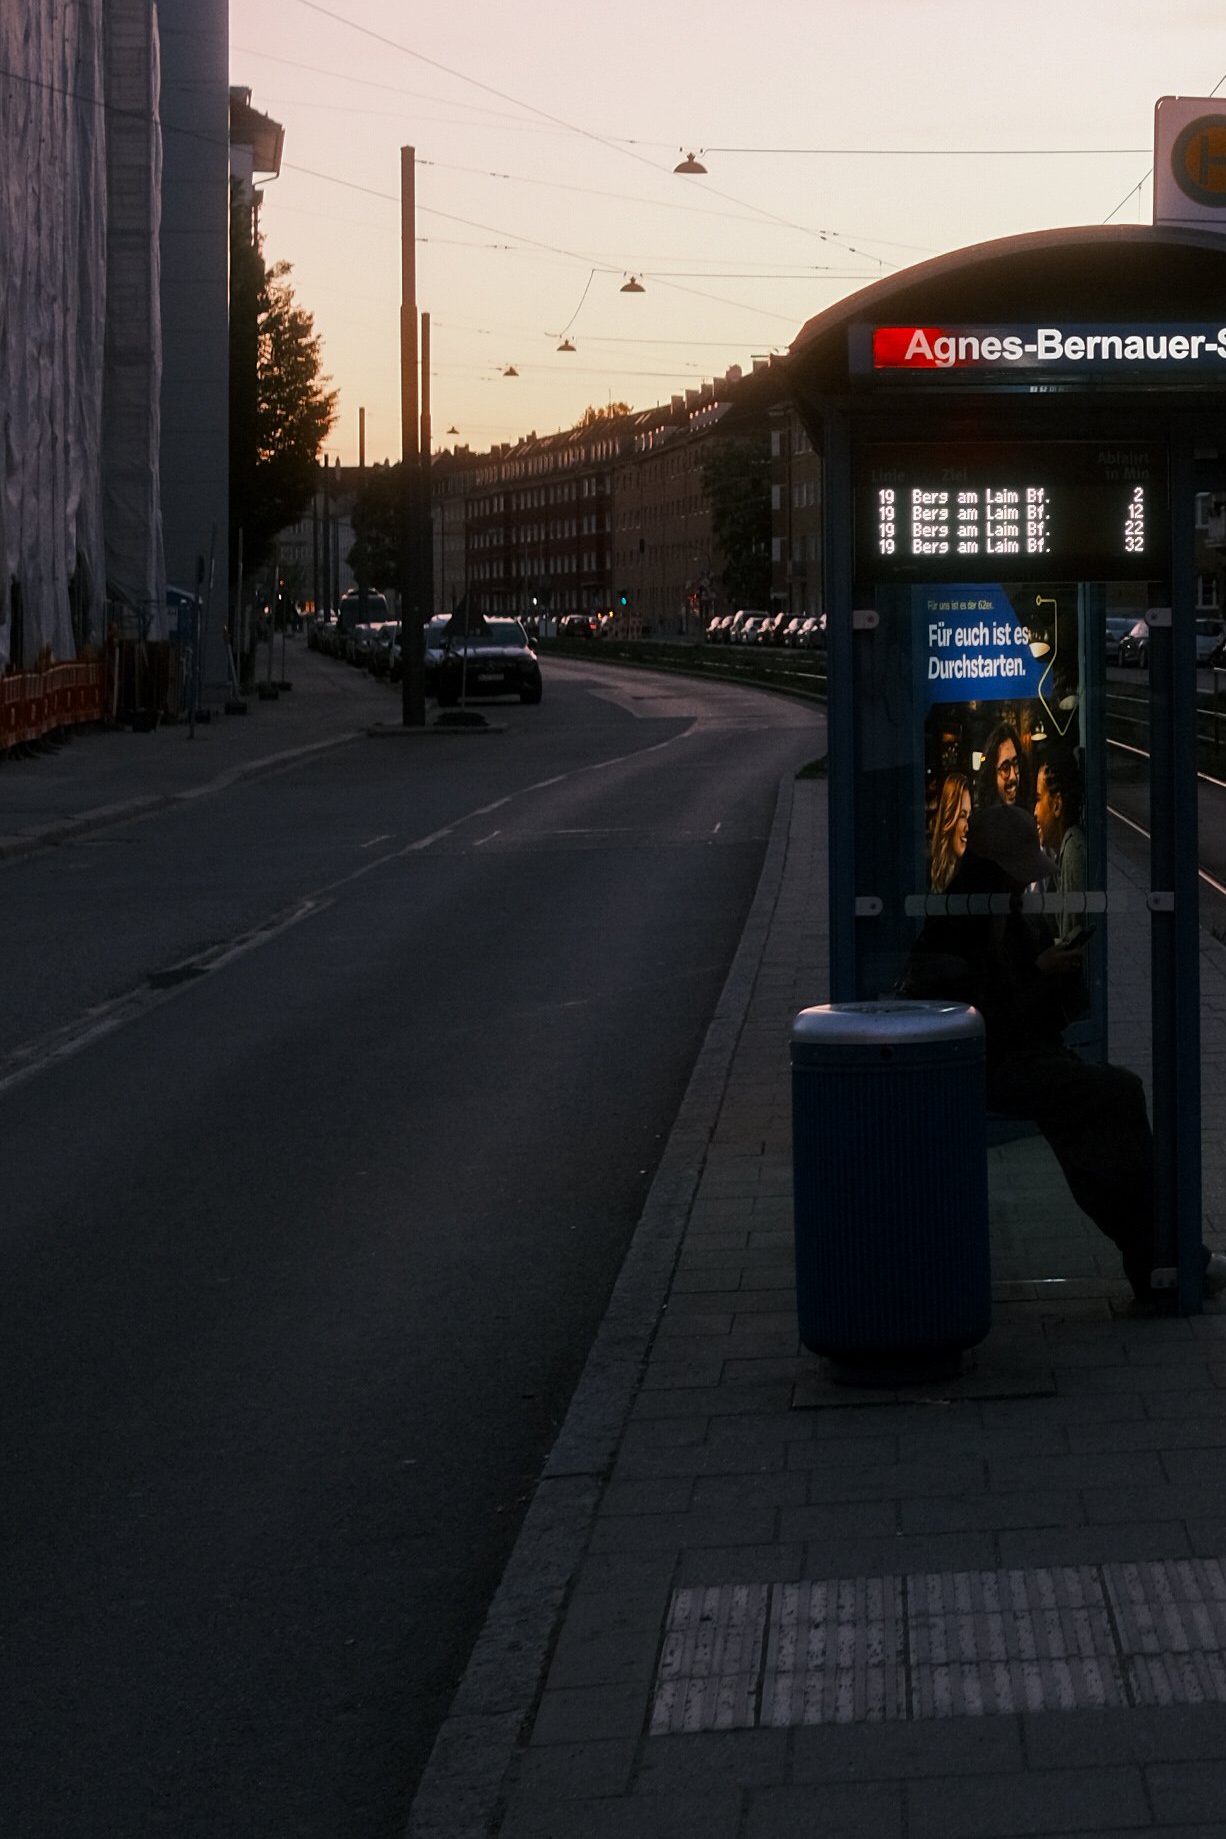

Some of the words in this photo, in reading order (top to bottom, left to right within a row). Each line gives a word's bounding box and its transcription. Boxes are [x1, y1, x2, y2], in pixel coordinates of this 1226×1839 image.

[1097, 449, 1149, 465] Abfahrt
[871, 469, 906, 482] Linie
[941, 468, 968, 482] Ziel
[1104, 466, 1119, 480] in
[1123, 466, 1149, 480] Min
[878, 488, 895, 504] 19
[912, 488, 949, 504] Berg
[957, 491, 978, 504] am
[986, 488, 1019, 504] Laim
[1026, 488, 1050, 504] Bf.
[1133, 487, 1144, 502] 2
[878, 505, 895, 521] 19
[912, 505, 949, 521] Berg
[957, 508, 978, 521] am
[986, 505, 1019, 521] Laim
[1026, 505, 1050, 521] Bf.
[1128, 503, 1144, 518] 12
[878, 522, 895, 537] 19
[912, 522, 949, 537] Berg
[957, 525, 978, 537] am
[986, 522, 1019, 537] Laim
[1026, 522, 1050, 537] Bf.
[1125, 520, 1144, 535] 22
[878, 538, 895, 554] 19
[912, 538, 949, 554] Berg
[957, 541, 978, 554] am
[986, 538, 1019, 554] Laim
[1026, 538, 1050, 554] Bf.
[1125, 537, 1144, 552] 32
[928, 600, 938, 610] Für
[939, 602, 950, 610] uns
[951, 600, 959, 610] ist
[960, 602, 967, 610] es
[967, 600, 977, 610] der
[929, 621, 952, 647] Für
[955, 621, 989, 647] euch
[993, 621, 1011, 646] ist
[1014, 626, 1029, 645] es
[928, 654, 1026, 680] Durchstarten.
